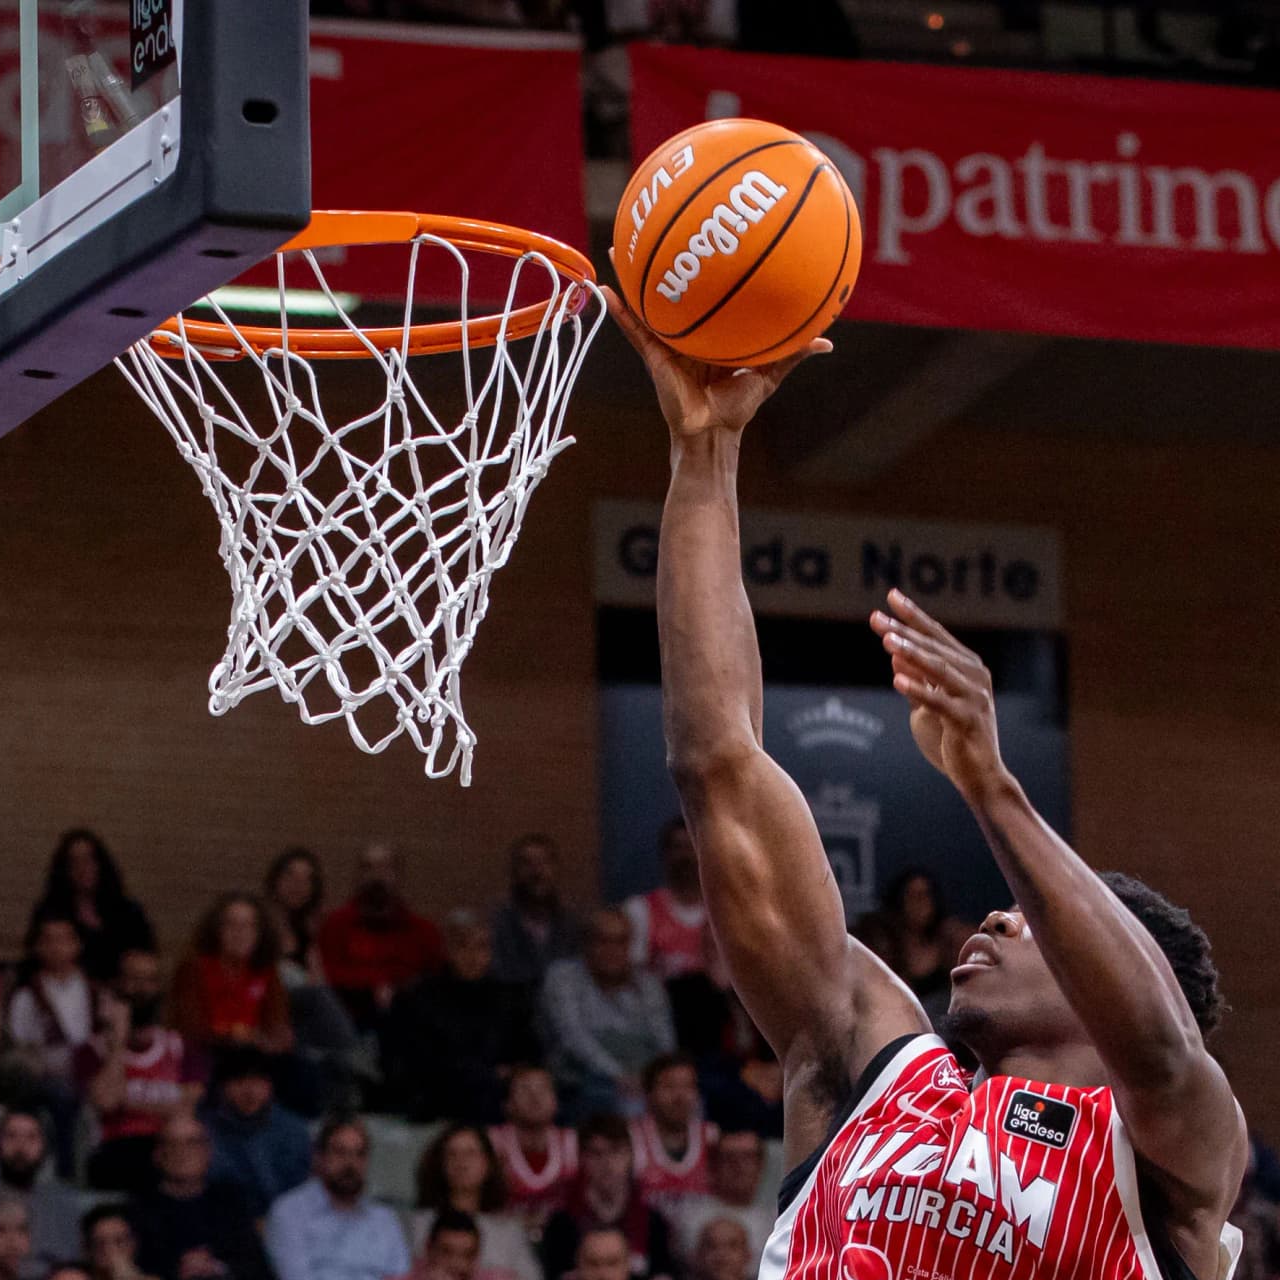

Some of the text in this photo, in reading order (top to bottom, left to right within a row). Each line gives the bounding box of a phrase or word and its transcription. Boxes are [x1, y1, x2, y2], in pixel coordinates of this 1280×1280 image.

[631, 144, 694, 232] EVO
[656, 170, 787, 303] Wilson
[619, 525, 1037, 603] Gda Norte
[1009, 1117, 1064, 1142] endesa
[1012, 1102, 1039, 1122] liga
[845, 1186, 1015, 1264] MURCIA
